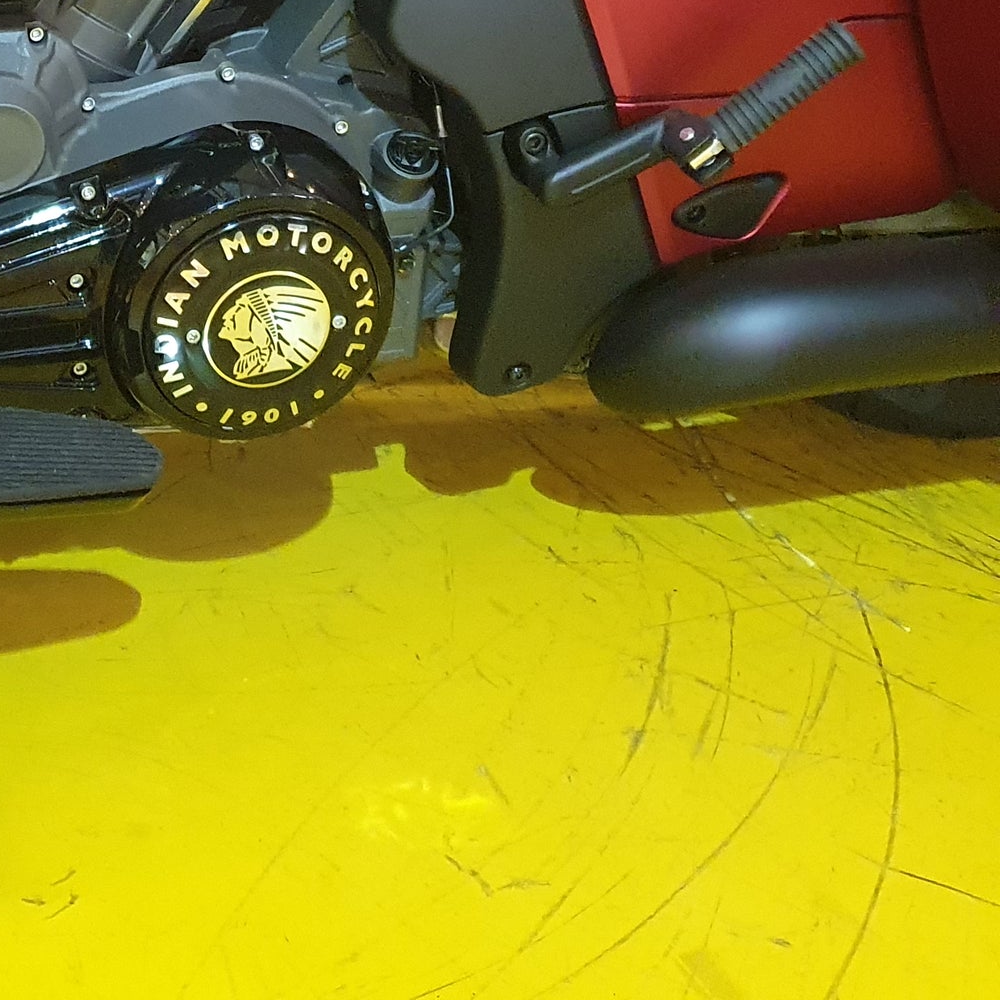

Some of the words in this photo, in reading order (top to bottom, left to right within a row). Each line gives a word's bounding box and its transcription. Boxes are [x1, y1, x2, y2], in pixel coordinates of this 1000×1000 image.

[154, 258, 211, 399] INDIAN
[219, 223, 375, 381] MOTORCYCLE
[219, 400, 300, 426] 1901
